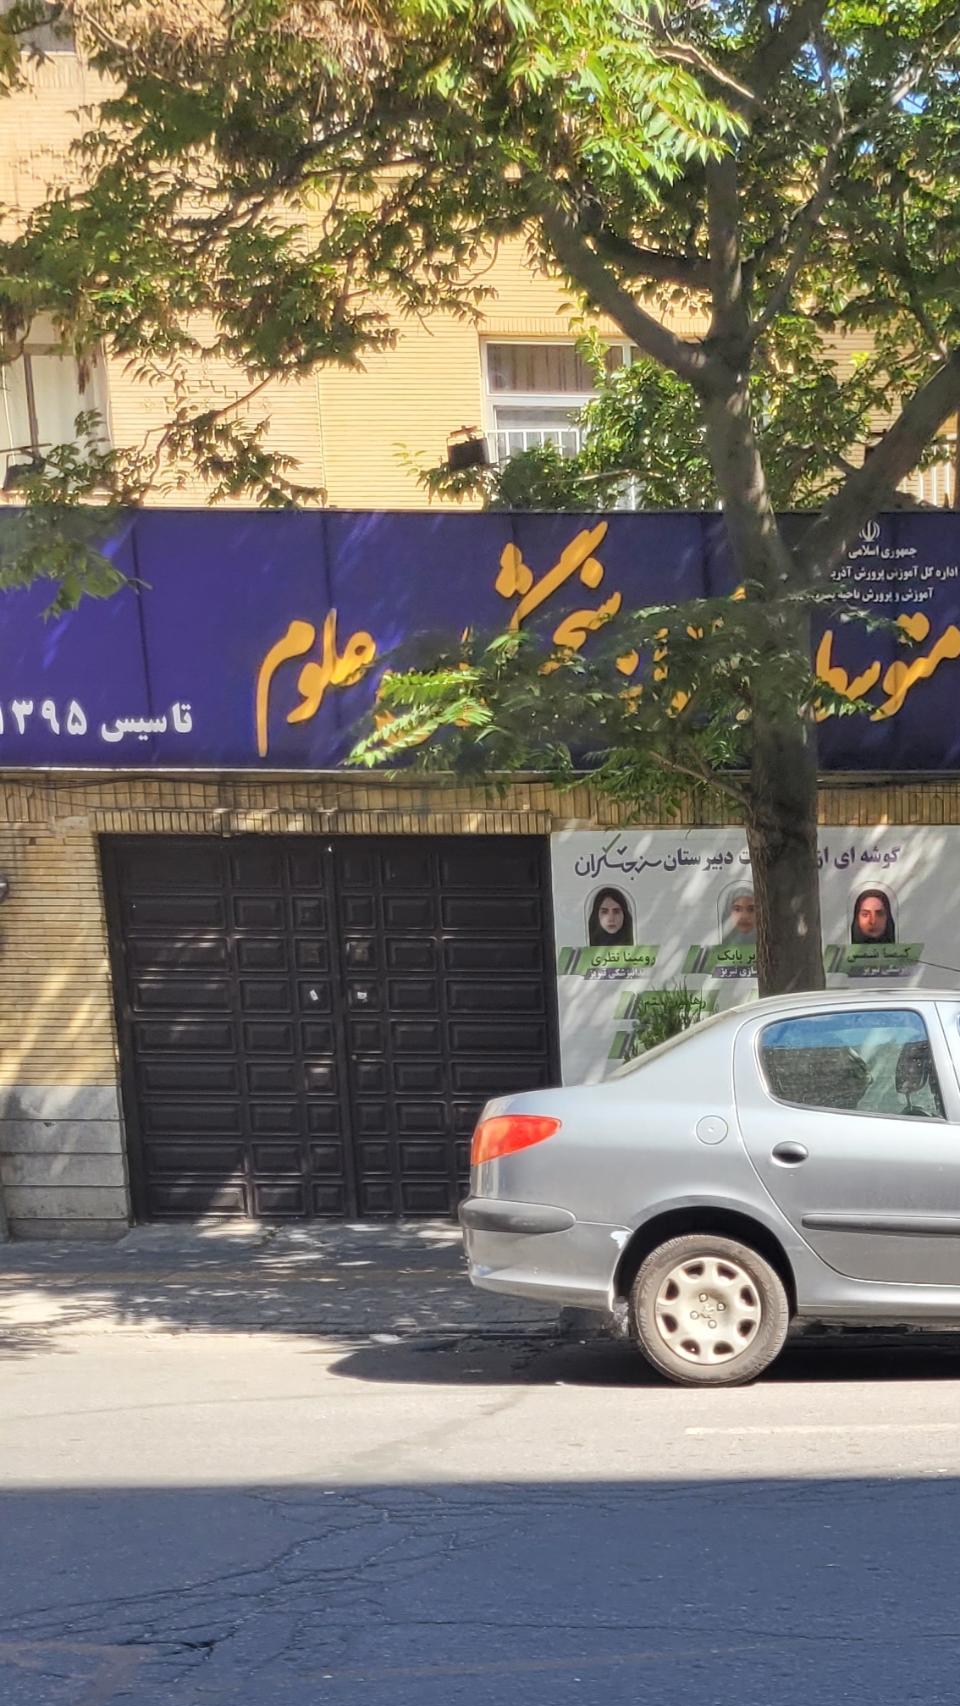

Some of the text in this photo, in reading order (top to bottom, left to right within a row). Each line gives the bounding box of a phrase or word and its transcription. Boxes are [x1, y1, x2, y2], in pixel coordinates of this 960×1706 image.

[848, 544, 880, 559] اسلامی
[854, 566, 885, 580] پرورش
[886, 565, 918, 580] آموزش
[936, 566, 958, 580] اداره
[862, 588, 893, 602] پرورش
[901, 587, 934, 602] آموزش
[101, 702, 192, 742] تاسیس
[664, 848, 734, 871] دبیرستان
[834, 846, 856, 869] ای
[860, 845, 900, 869] گوشه
[591, 952, 656, 968] رومینا نظری
